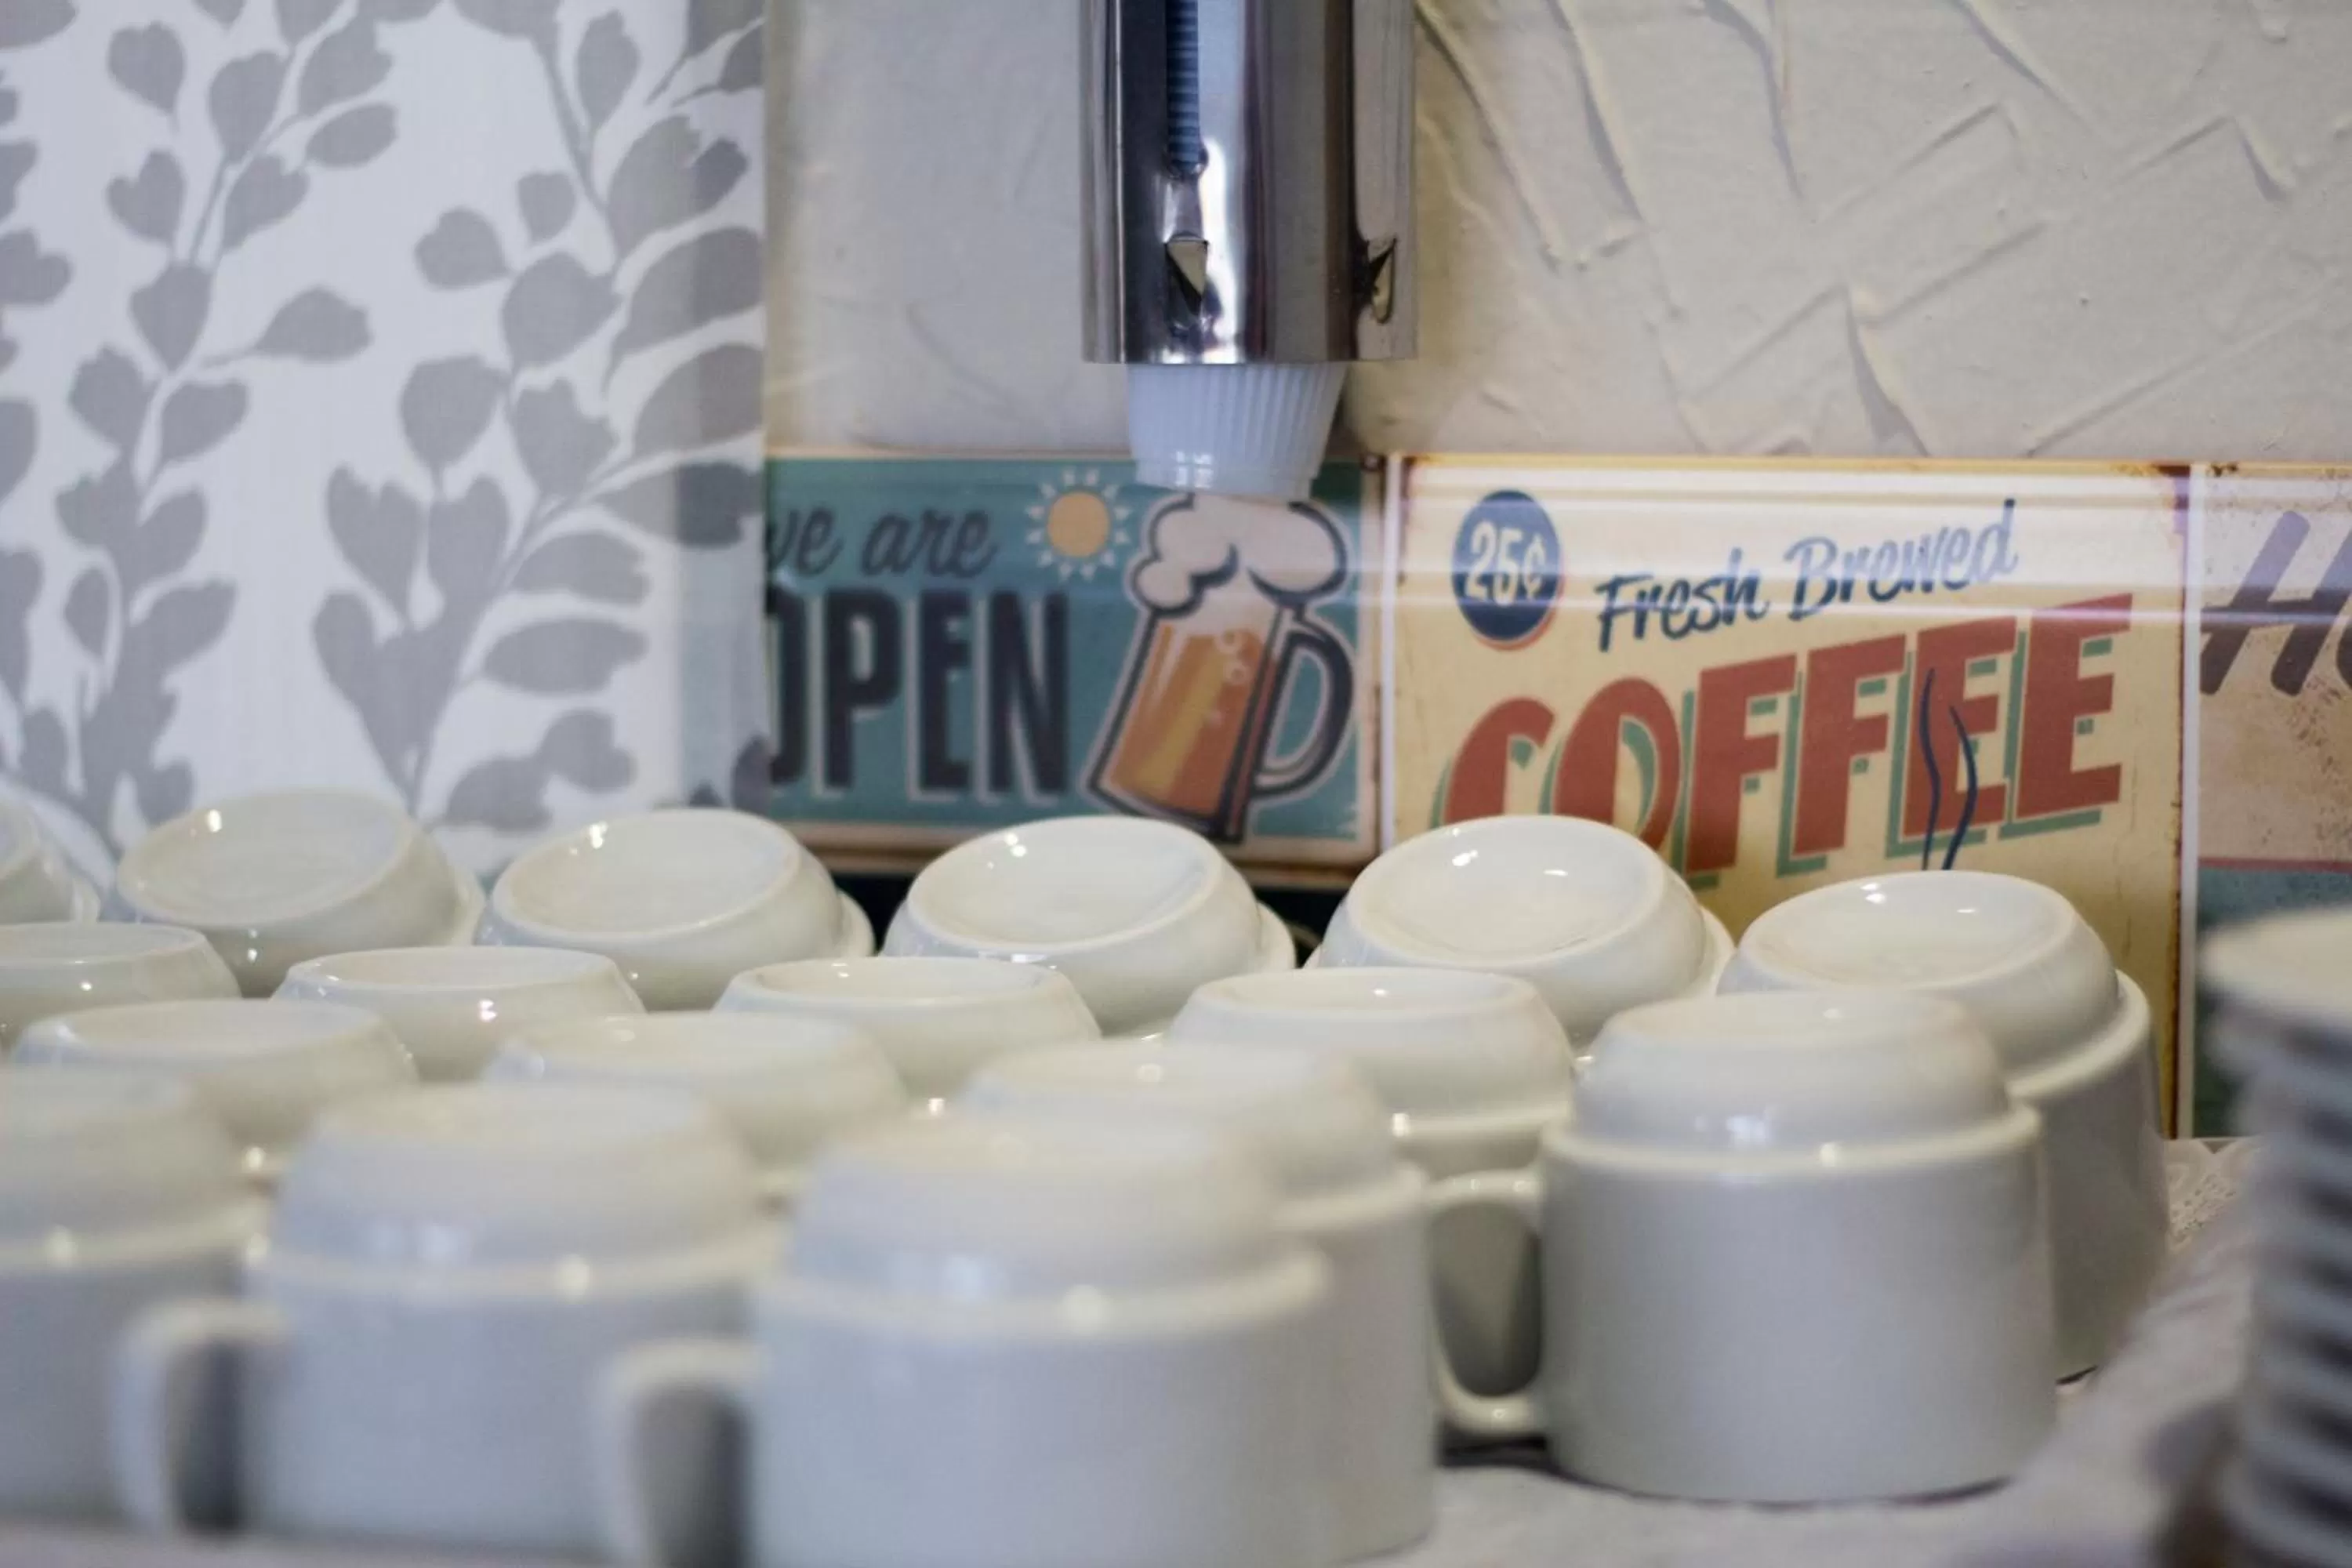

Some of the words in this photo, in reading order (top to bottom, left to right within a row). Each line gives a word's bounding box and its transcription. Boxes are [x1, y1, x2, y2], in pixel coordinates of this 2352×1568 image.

[859, 510, 1000, 579] are
[1595, 549, 1769, 653] Fresh
[1784, 498, 2019, 621] Brewed
[2200, 510, 2352, 697] H
[1439, 593, 2133, 877] COFFEE
